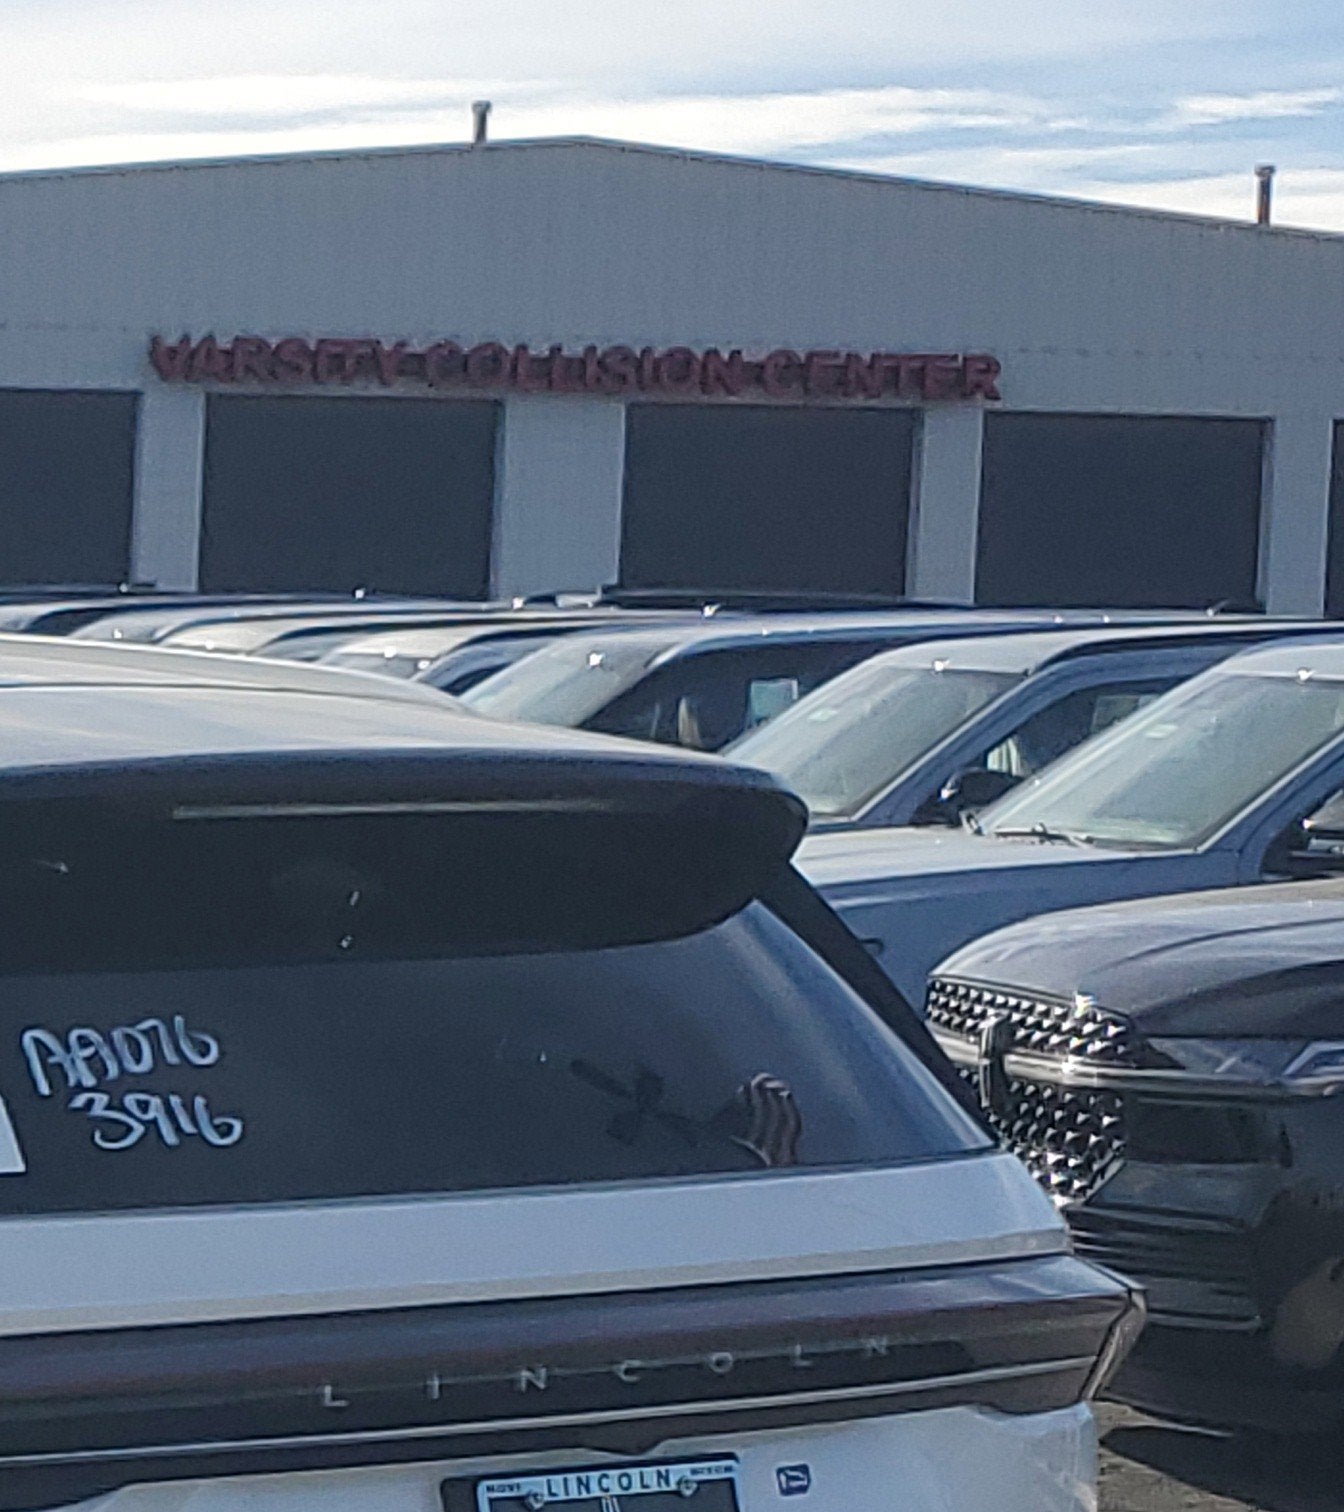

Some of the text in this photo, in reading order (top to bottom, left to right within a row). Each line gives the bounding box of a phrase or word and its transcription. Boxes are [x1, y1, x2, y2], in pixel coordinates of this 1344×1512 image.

[148, 332, 1002, 402] VARSITY COLLISION CENTER
[68, 1091, 243, 1150] 3916
[322, 1335, 890, 1408] LINCOLN
[544, 1467, 672, 1499] LINCOLN
